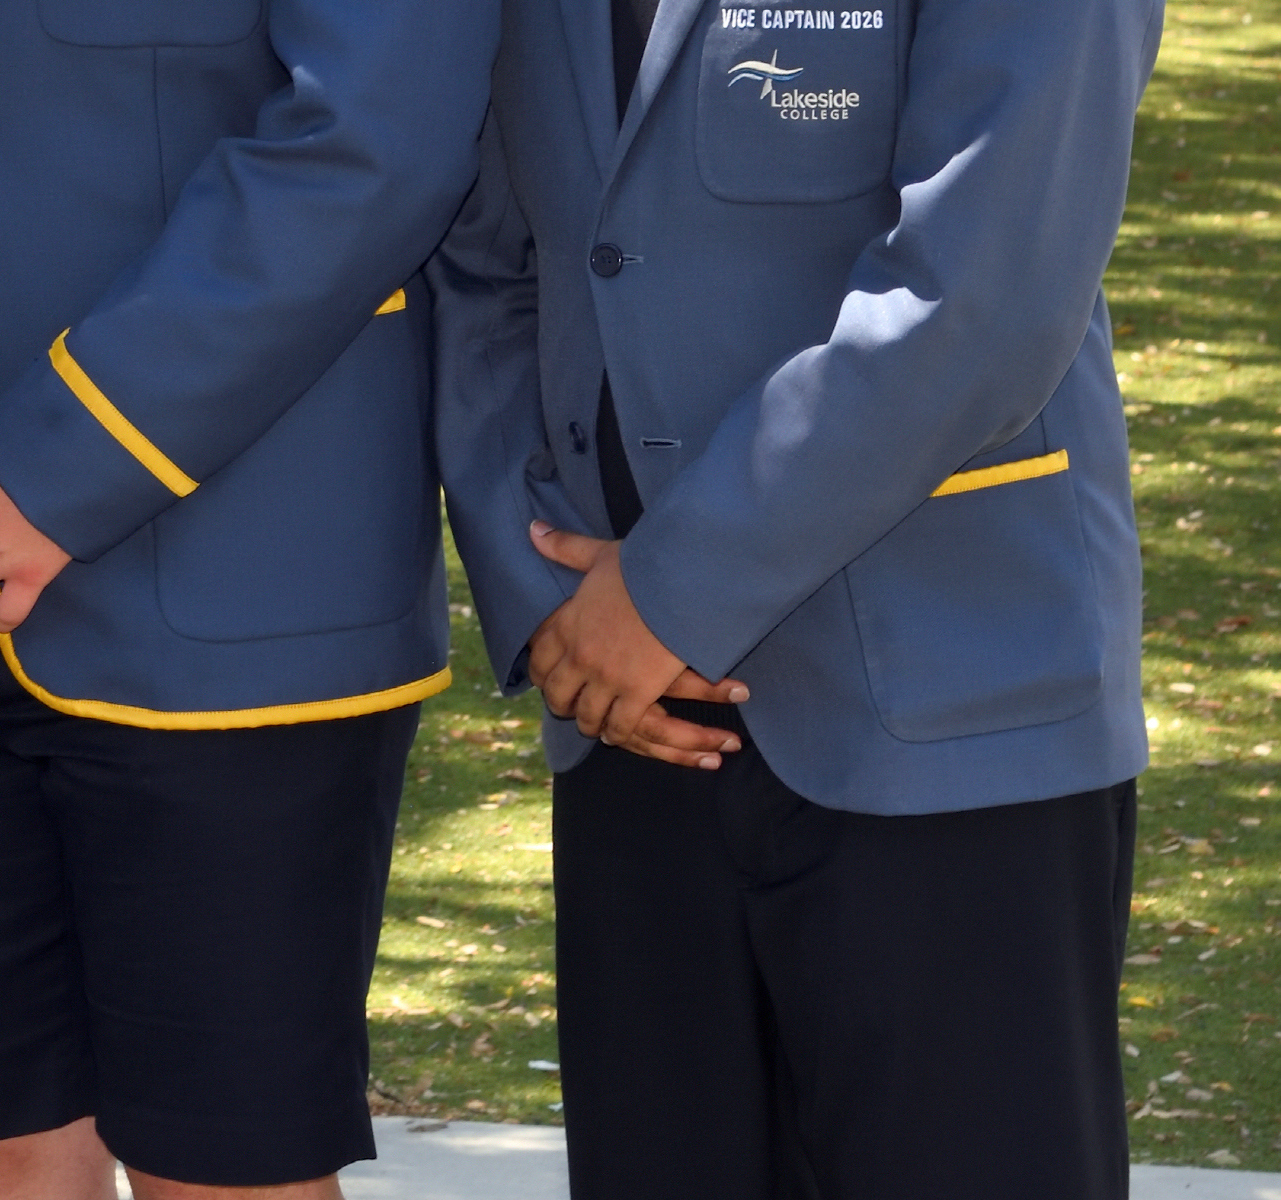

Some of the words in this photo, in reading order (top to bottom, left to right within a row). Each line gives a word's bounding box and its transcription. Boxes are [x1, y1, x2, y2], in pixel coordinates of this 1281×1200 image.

[721, 9, 755, 29] VICE
[762, 9, 835, 30] CAPTAIN
[840, 10, 884, 30] 2026
[771, 88, 860, 108] Lakeside
[780, 108, 849, 121] COLLEGE
